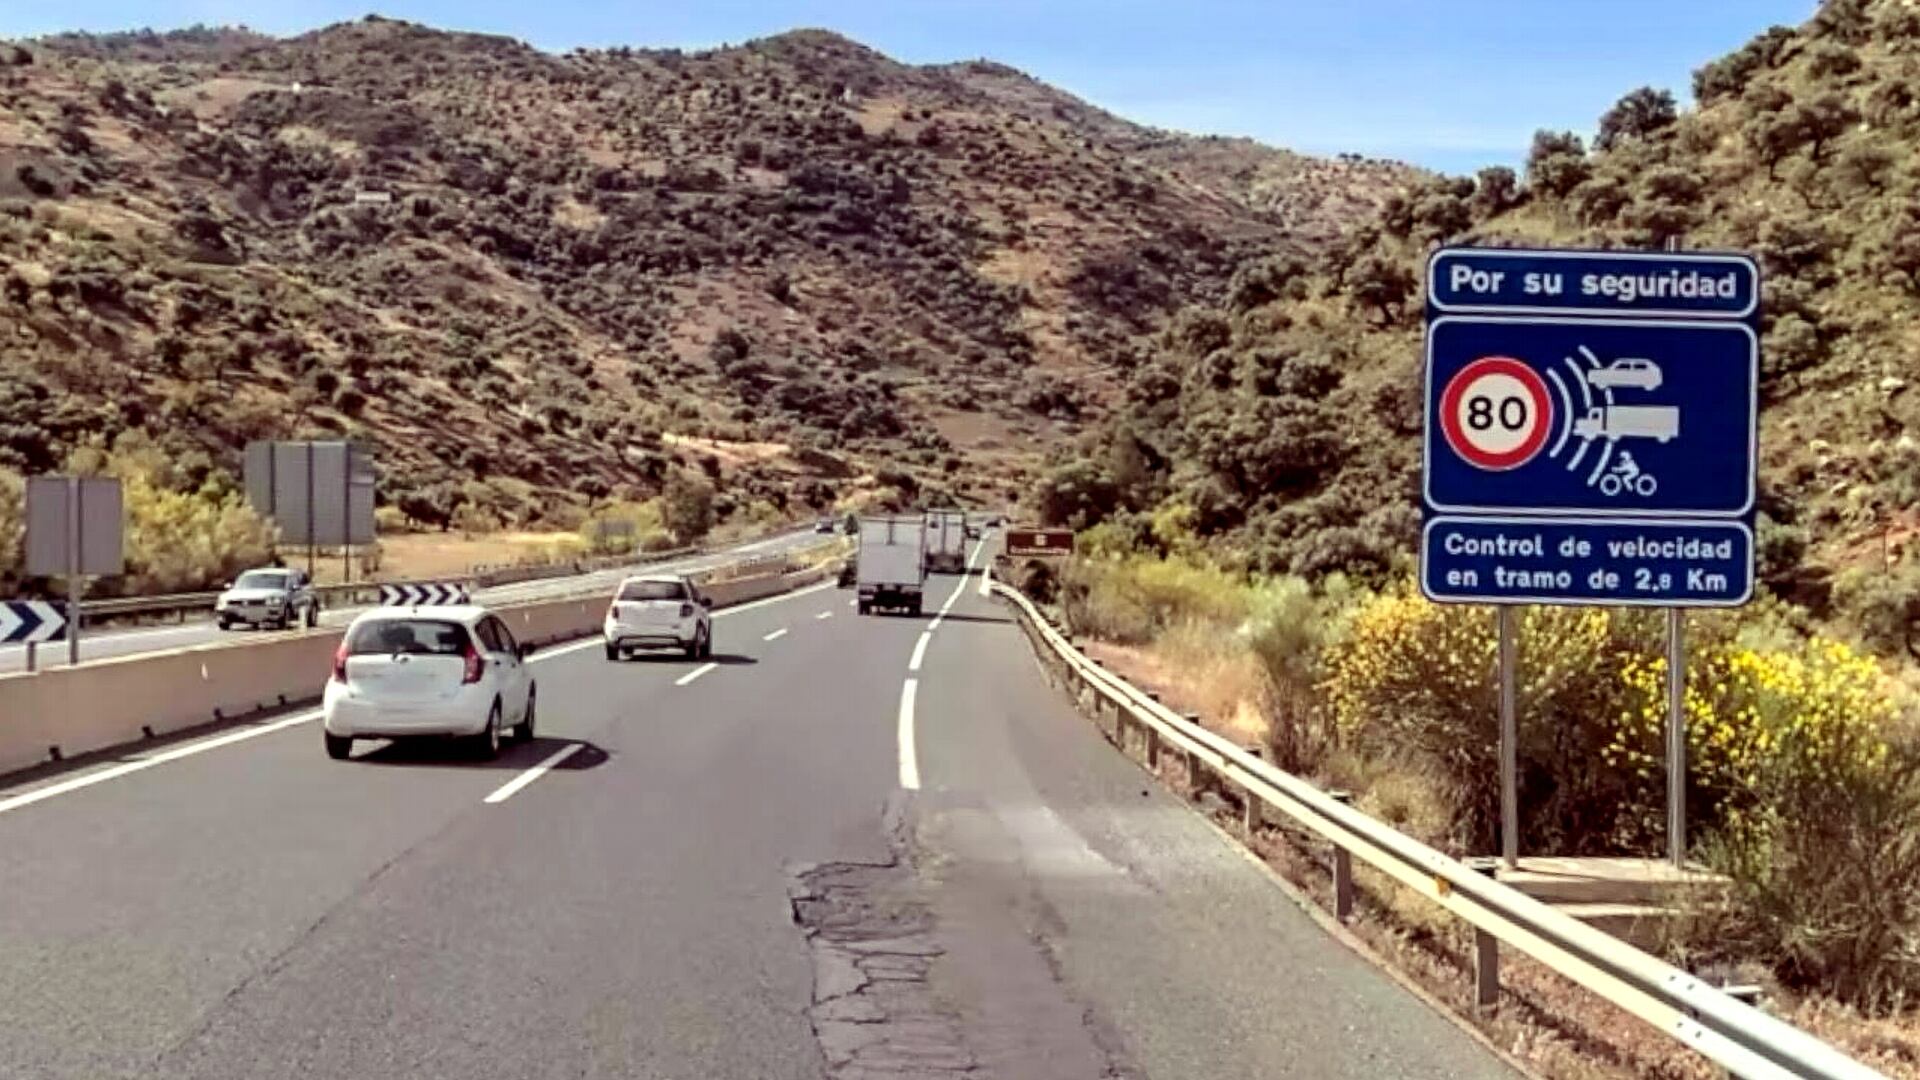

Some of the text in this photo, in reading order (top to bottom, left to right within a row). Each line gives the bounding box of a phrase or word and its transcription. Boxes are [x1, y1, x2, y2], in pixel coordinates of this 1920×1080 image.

[1450, 264, 1737, 302] Por su seguridad
[1467, 396, 1527, 430] 80
[1444, 533, 1732, 560] Control de velocidad
[1446, 569, 1478, 588] en
[1495, 566, 1571, 589] tramo
[1588, 568, 1620, 590] de
[1687, 569, 1727, 591] Km
